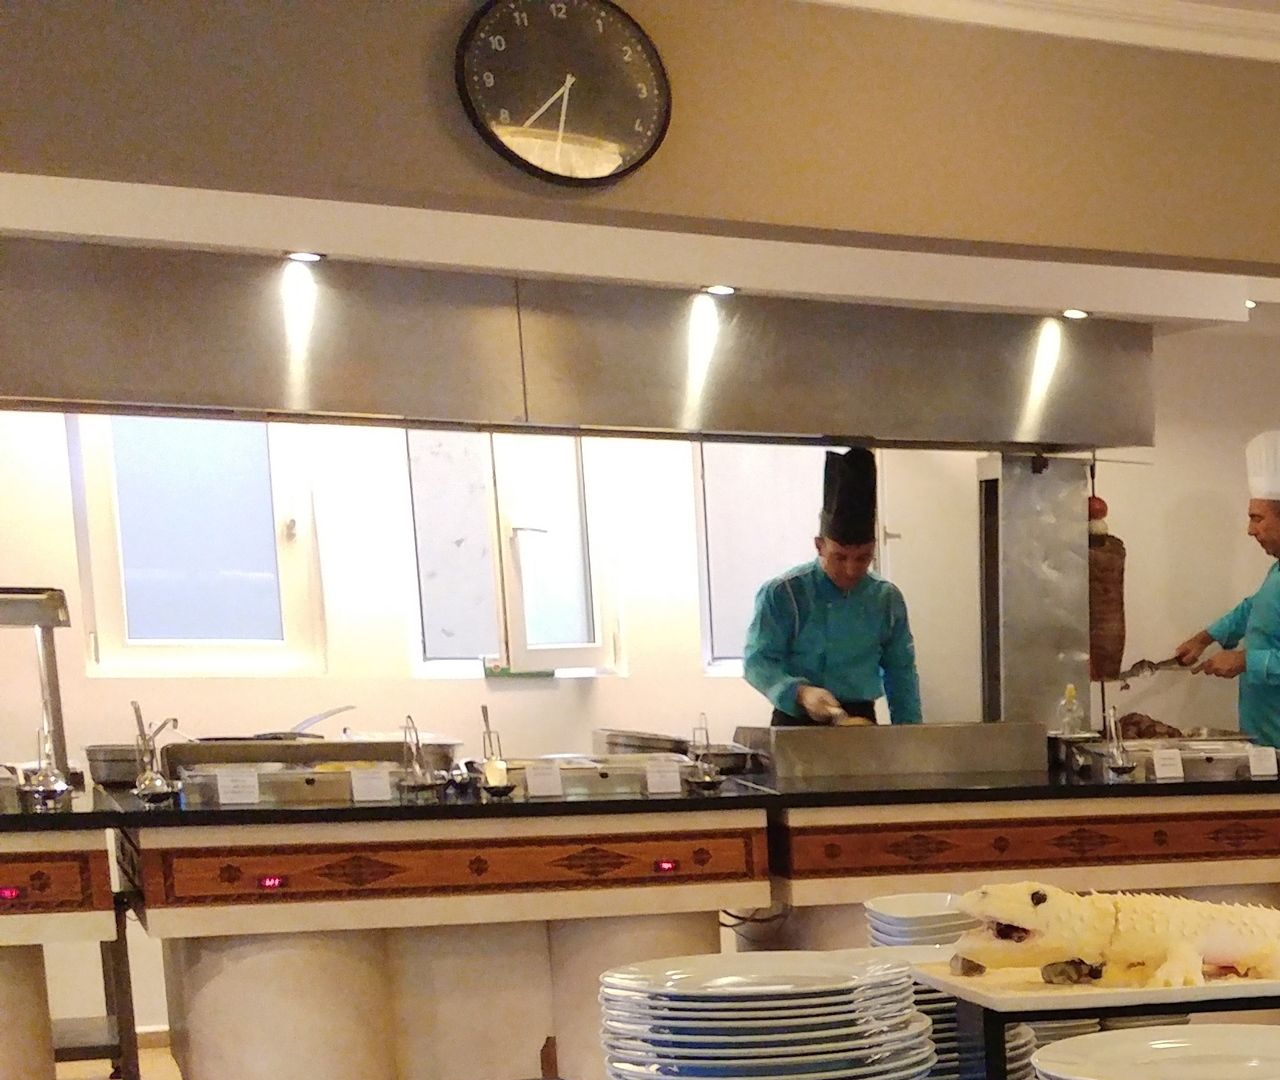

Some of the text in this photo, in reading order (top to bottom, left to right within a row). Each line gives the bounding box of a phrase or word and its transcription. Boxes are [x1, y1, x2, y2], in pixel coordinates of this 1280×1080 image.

[550, 4, 567, 18] 12
[513, 12, 528, 26] 11
[596, 18, 604, 32] 1
[488, 35, 506, 51] 10
[622, 46, 633, 62] 2
[483, 71, 495, 87] 9
[637, 82, 648, 98] 3
[500, 109, 511, 123] 8
[634, 118, 643, 132] 4
